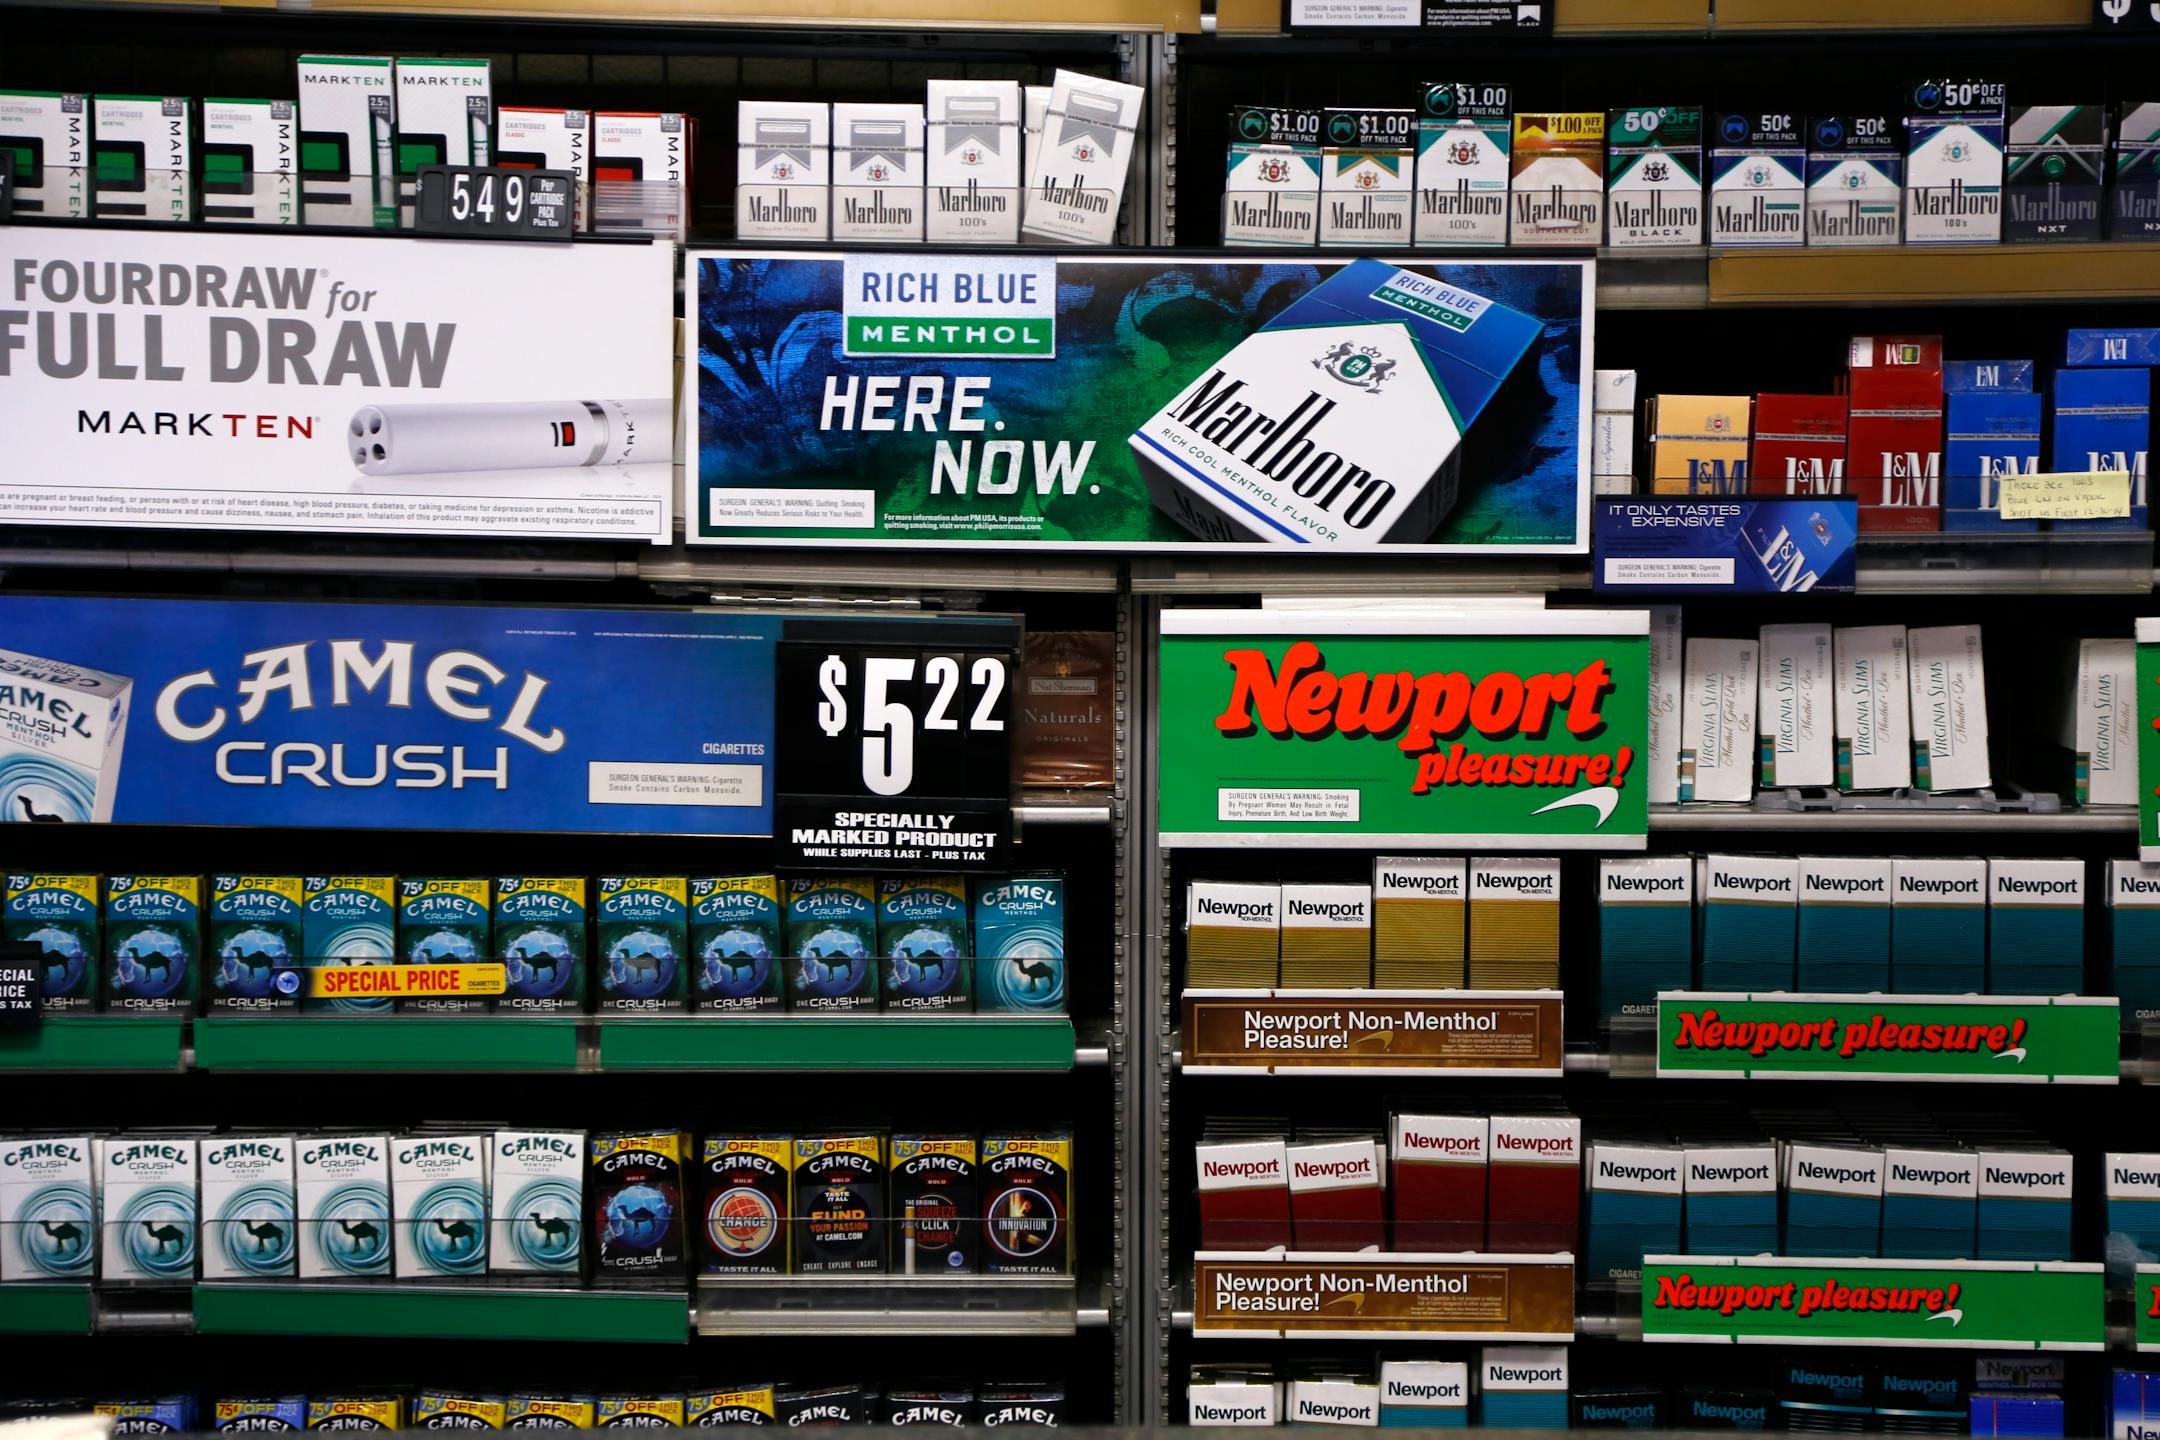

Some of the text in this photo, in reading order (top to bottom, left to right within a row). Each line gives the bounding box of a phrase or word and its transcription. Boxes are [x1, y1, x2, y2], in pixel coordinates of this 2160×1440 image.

[304, 74, 384, 86] MARKTEN
[403, 76, 482, 86] MARKTEN
[1457, 86, 1506, 106] $1.00
[1946, 83, 2004, 106] 50¢ OFF
[1458, 106, 1470, 114] OFF
[1486, 107, 1504, 115] PACK
[1624, 108, 1699, 132] 50¢ OFF
[1270, 114, 1320, 134] $1.00
[1360, 114, 1409, 134] $1.00
[1551, 116, 1602, 134] $1.00 OFF
[1761, 114, 1791, 132] 50¢
[1856, 118, 1886, 136] 50¢
[541, 178, 555, 192] Per
[938, 178, 1006, 212] Marlboro
[1040, 174, 1109, 214] Marlboro
[530, 192, 564, 206] CARTRIDGE
[749, 189, 817, 224] Marlboro
[1422, 179, 1502, 215] Marlboro
[1912, 179, 1998, 216] Marlboro
[2010, 184, 2097, 221] Marlboro
[538, 206, 555, 218] PACK
[1232, 192, 1311, 231] Marlboro
[1331, 196, 1401, 231] Marlboro
[1613, 190, 1697, 228] Marlboro
[1810, 200, 1895, 237] Marlboro
[532, 218, 559, 228] Plus Tax
[960, 217, 987, 227] 100's
[2037, 225, 2068, 233] NXT
[1630, 228, 1682, 237] BLACK
[863, 272, 1037, 304] RICH BLUE
[1396, 274, 1481, 314] RICH BLUE
[325, 281, 376, 318] for
[1380, 290, 1464, 327] MENTHOL
[862, 325, 1040, 344] MENTHOL
[0, 310, 456, 388] FULL DRAW
[1976, 366, 2000, 387] L&M
[819, 376, 1006, 431] HERE.
[78, 410, 313, 440] MARKTEN
[1166, 368, 1396, 530] Marlboro
[930, 440, 1100, 495] NOW.
[1687, 458, 1748, 494] L&M
[1785, 457, 1845, 494] L&M
[1161, 427, 1338, 543] RICH COOL MENTHOL FLAVOR
[1880, 452, 1941, 507] L&M
[367, 512, 404, 521] Inhalation
[416, 514, 430, 522] this
[432, 514, 461, 524] product
[463, 517, 478, 525] may
[481, 515, 518, 526] aggravate
[520, 516, 550, 527] existing
[552, 517, 593, 528] respiratory
[596, 518, 637, 527] conditions.
[1609, 505, 1740, 516] IT ONLY TASTES
[1632, 517, 1725, 527] EXPENSIVE
[1760, 525, 1819, 592] L&M
[155, 639, 566, 752] CAMEL
[1214, 641, 1611, 751] Newport
[1776, 657, 1794, 753] VIRGINIA SLIMS
[1024, 706, 1102, 724] Naturals
[1928, 662, 1950, 758] VIRGINIA SLIMS
[6, 722, 57, 743] MENTHOL
[2092, 674, 2112, 771] VIRGINIA SLIMS
[703, 743, 765, 756] CIGARETTES
[215, 740, 509, 790] CRUSH
[1411, 742, 1632, 795] pleasure!
[835, 812, 955, 829] SPECIALLY
[792, 829, 997, 848] MARKED PRODUCT
[803, 848, 985, 860] WHILE SUPPLIES LAST PLUS TAX
[110, 877, 168, 891] 75¢ OFF
[1383, 872, 1458, 891] Newport
[1607, 874, 1684, 893] Newport
[1805, 874, 1884, 893] Newport
[1998, 876, 2078, 895] Newport
[12, 892, 85, 913] CAMEL
[114, 893, 186, 913] CAMEL
[502, 893, 573, 914] CAMEL
[698, 893, 769, 916] CAMEL
[981, 885, 1057, 906] CAMEL
[999, 902, 1043, 910] CRUSH
[1198, 898, 1273, 918] Newport
[325, 969, 460, 992] SPECIAL PRICE
[1244, 1010, 1496, 1033] Newport Non-Menthol
[1244, 1030, 1348, 1049] Pleasure!
[1676, 1010, 2026, 1058] Newport pleasure!
[727, 1140, 759, 1152] OFF
[1404, 1132, 1480, 1151] Newport
[3, 1143, 82, 1166] CAMEL
[399, 1142, 474, 1166] CAMEL
[604, 1154, 667, 1173] CAMEL
[1203, 1159, 1279, 1178] Newport
[1600, 1162, 1676, 1181] Newport
[1986, 1167, 2065, 1186] Newport
[720, 1216, 766, 1229] CHANGE
[811, 1210, 865, 1220] FUND
[999, 1219, 1047, 1231] INNOVATION
[833, 1222, 868, 1232] PASSION
[922, 1221, 950, 1231] CLICK
[824, 1232, 863, 1241] CAMEL.COM
[1216, 1273, 1468, 1295] Newport Non-Menthol
[1216, 1292, 1320, 1312] Pleasure!
[1655, 1275, 1960, 1316] Newport pleasure!
[1489, 1366, 1562, 1382] Newport
[1791, 1370, 1864, 1389] Newport
[892, 1407, 965, 1427] CAMEL
